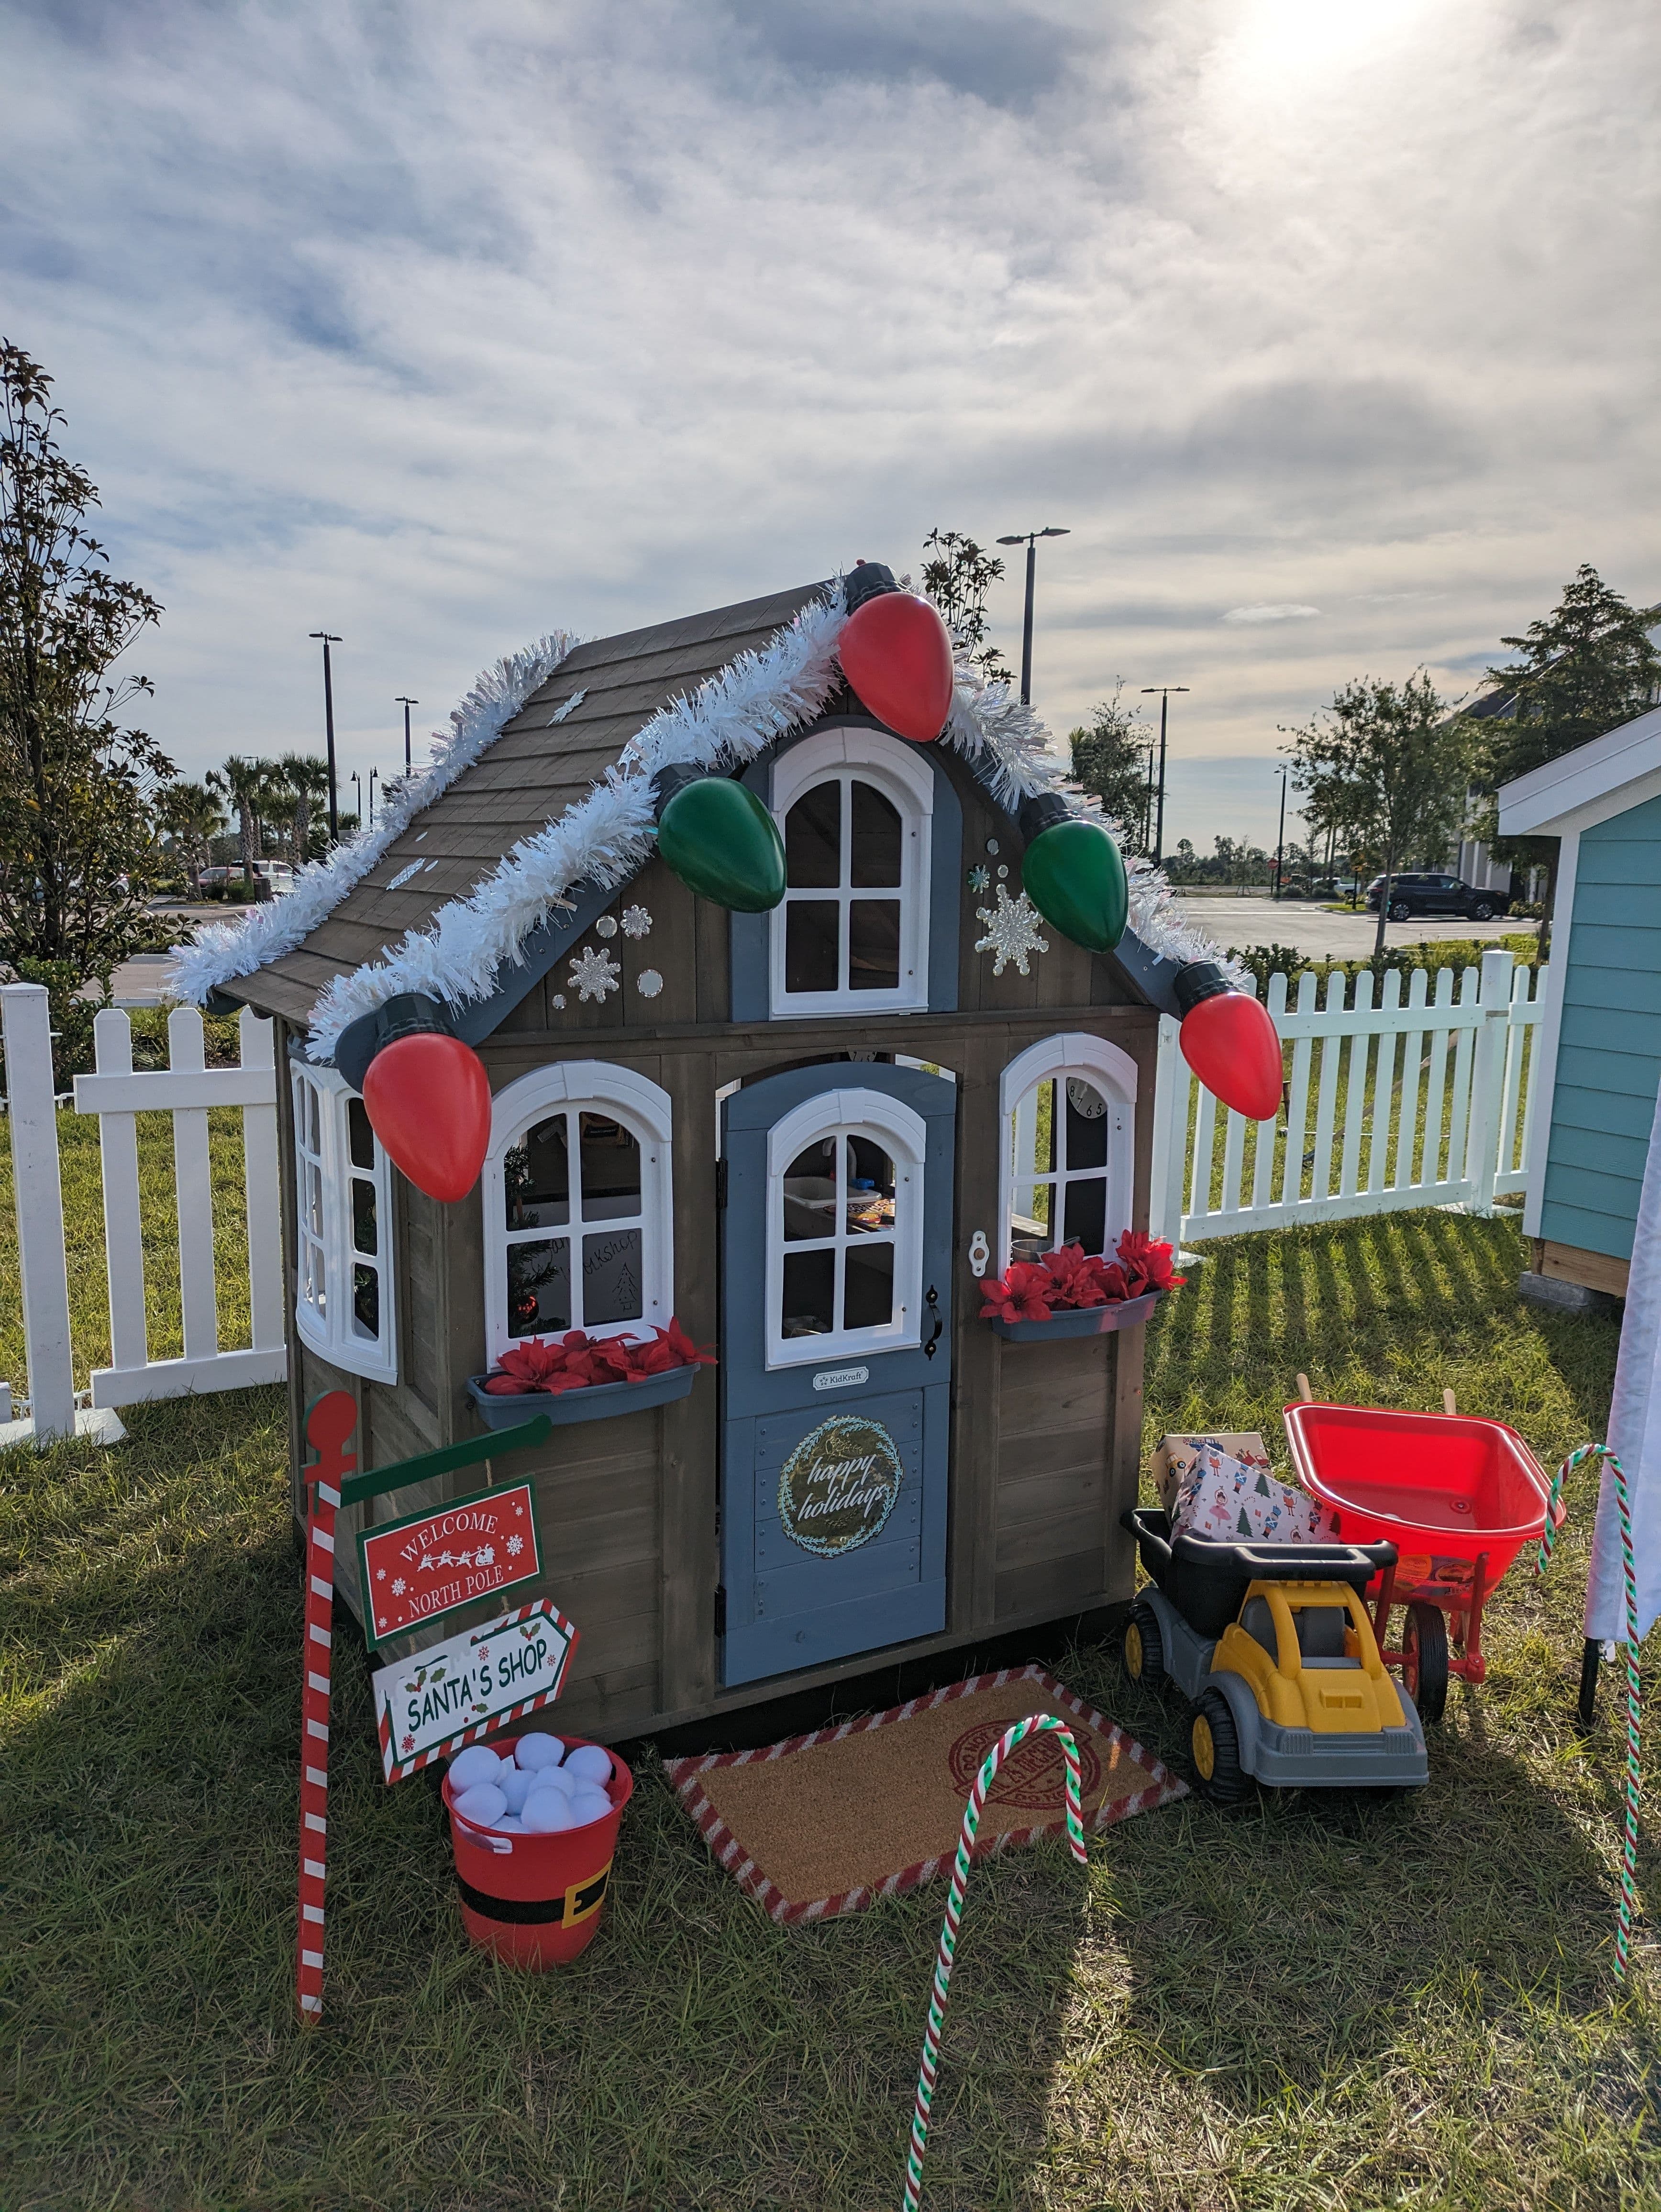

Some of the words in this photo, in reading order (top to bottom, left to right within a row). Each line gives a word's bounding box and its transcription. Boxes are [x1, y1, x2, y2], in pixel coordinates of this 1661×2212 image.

[1070, 1086, 1074, 1097] 8
[1078, 1097, 1083, 1109] 7
[1086, 1105, 1092, 1117] 6
[1096, 1103, 1102, 1115] 5
[830, 1371, 862, 1384] KidKraft
[807, 1454, 876, 1494] happy
[797, 1481, 887, 1521] holidays
[399, 1512, 498, 1562] WELCOME
[409, 1581, 462, 1618] NORTH
[465, 1565, 504, 1595] POLE
[408, 1665, 492, 1732] SANTA'S
[498, 1638, 547, 1688] SHOP
[963, 1730, 988, 1752] NOT
[962, 1755, 977, 1770] DO
